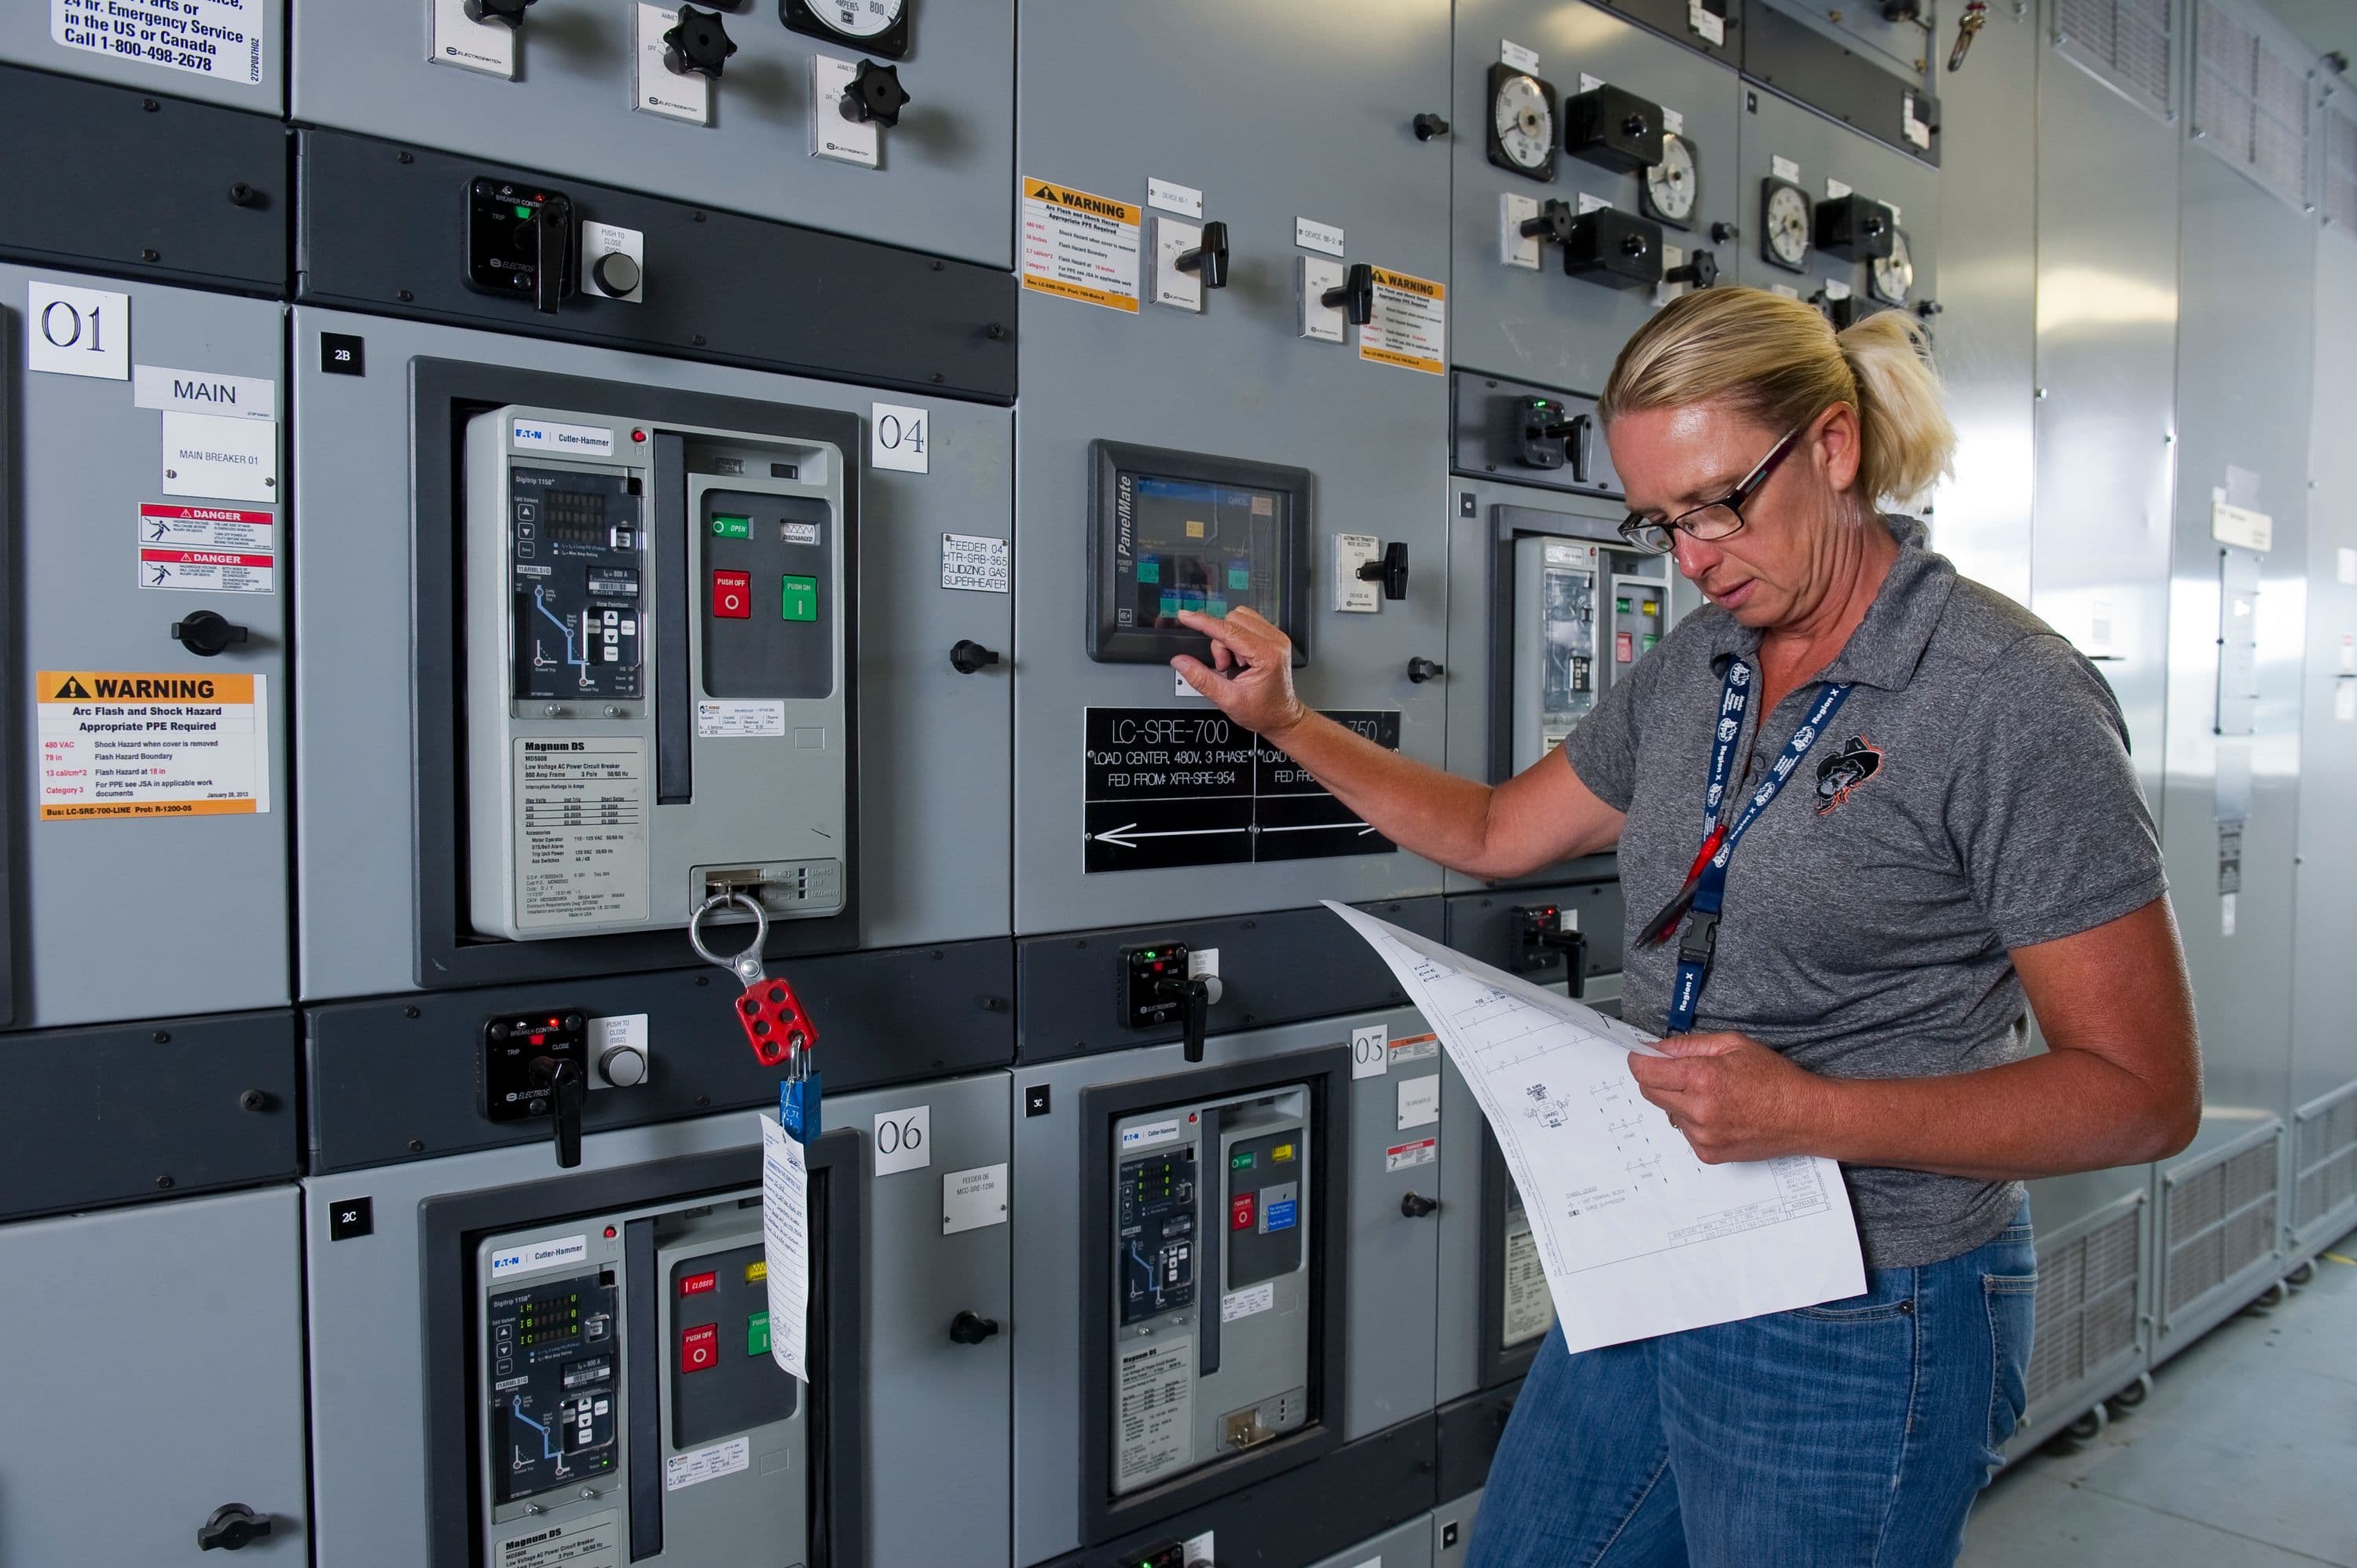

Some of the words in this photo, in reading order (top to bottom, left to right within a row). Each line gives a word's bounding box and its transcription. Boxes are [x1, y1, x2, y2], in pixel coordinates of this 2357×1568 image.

[183, 4, 199, 16] or
[835, 0, 860, 12] AMPERES
[869, 3, 885, 16] 800
[85, 1, 104, 13] hr.
[108, 2, 188, 34] Emergency
[191, 20, 244, 43] Service
[65, 10, 79, 26] in
[84, 15, 109, 32] the
[114, 19, 136, 38] US
[140, 27, 157, 42] or
[160, 30, 218, 56] Canada
[64, 27, 96, 48] Call
[101, 35, 213, 71] 1-800-498-2678
[250, 37, 259, 82] 272P087H02
[457, 50, 502, 64] ELECTROSWITCH
[658, 100, 698, 113] ELECTROSWITCH
[835, 146, 869, 157] ELECTROSWITCH
[1162, 192, 1177, 202] DEVICE
[1061, 192, 1126, 219] WARNING
[1048, 213, 1080, 227] Appropriate
[1081, 221, 1093, 230] PPE
[1094, 223, 1118, 236] Required
[601, 228, 617, 238] PUSH
[618, 231, 625, 240] TO
[1305, 229, 1322, 240] DEVICE
[603, 237, 622, 247] CLOSE
[1388, 275, 1435, 296] WARNING
[335, 350, 350, 361] 2B
[174, 379, 236, 405] MAIN
[559, 434, 610, 447] Cutler-Hammer
[878, 415, 925, 453] 04
[179, 449, 203, 461] MAIN
[205, 452, 247, 464] BREAKER
[247, 456, 258, 466] 01
[515, 476, 537, 485] Digitrip
[193, 511, 241, 521] DANGER
[1117, 475, 1132, 557] PanelMate
[783, 534, 813, 543] DISCHARGED
[950, 540, 988, 553] FEEDER
[992, 544, 1003, 554] 04
[193, 554, 241, 564] DANGER
[944, 552, 1007, 566] HTR-SRB-365
[1116, 559, 1133, 568] POWER
[944, 564, 986, 576] FLUIDIZING
[988, 568, 1006, 578] GAS
[717, 578, 734, 587] PUSH
[944, 576, 1006, 589] SUPERHEATER
[94, 680, 214, 698] WARNING
[73, 707, 92, 716] Arc
[95, 706, 124, 716] Flash
[127, 707, 147, 716] and
[150, 706, 183, 716] Shock
[185, 707, 222, 716] Hazard
[1811, 696, 1834, 724] Region
[1830, 687, 1840, 698] X
[79, 722, 143, 733] Appropriate
[146, 722, 167, 731] PPE
[170, 722, 216, 732] Required
[1113, 719, 1230, 745] LC-SRE-700
[525, 742, 569, 752] Magnum
[571, 742, 585, 751] DS
[141, 753, 173, 761] Boundary
[1094, 752, 1122, 766] LOAD
[1126, 751, 1171, 766] CENTER,
[1174, 750, 1203, 765] 480V,
[1205, 750, 1213, 764] 3
[1215, 749, 1248, 764] PHASE
[1263, 750, 1288, 764] LOAD
[1716, 745, 1728, 773] Region
[161, 779, 196, 788] applicable
[1109, 773, 1131, 787] FED
[1134, 772, 1167, 786] FROM:
[1169, 771, 1236, 785] XFR-SRE-954
[1274, 771, 1294, 783] FED
[46, 786, 79, 796] Category
[66, 806, 131, 815] LC-SRE-700-LINE
[135, 805, 153, 814] Prot:
[1730, 814, 1751, 841] Region
[1749, 806, 1756, 815] X
[1685, 972, 1694, 980] X
[1679, 981, 1693, 1013] Region
[606, 1020, 620, 1029] PUSH
[511, 1027, 535, 1038] BREAKER
[535, 1026, 560, 1035] CONTROL
[609, 1028, 627, 1037] CLOSE
[552, 1042, 570, 1051] CLOSE
[610, 1035, 627, 1046] (DISC)
[507, 1048, 520, 1057] TRIP
[1354, 1034, 1384, 1064] 03
[877, 1116, 922, 1154] 06
[962, 1174, 982, 1185] FEEDER
[982, 1173, 990, 1181] 06
[342, 1211, 357, 1224] 2C
[534, 1244, 583, 1260] Cutler-Hammer
[691, 1279, 713, 1291] CLOSED
[685, 1332, 702, 1343] PUSH
[701, 1330, 713, 1341] OFF
[505, 1533, 548, 1551] Magnum
[548, 1528, 563, 1538] DS
